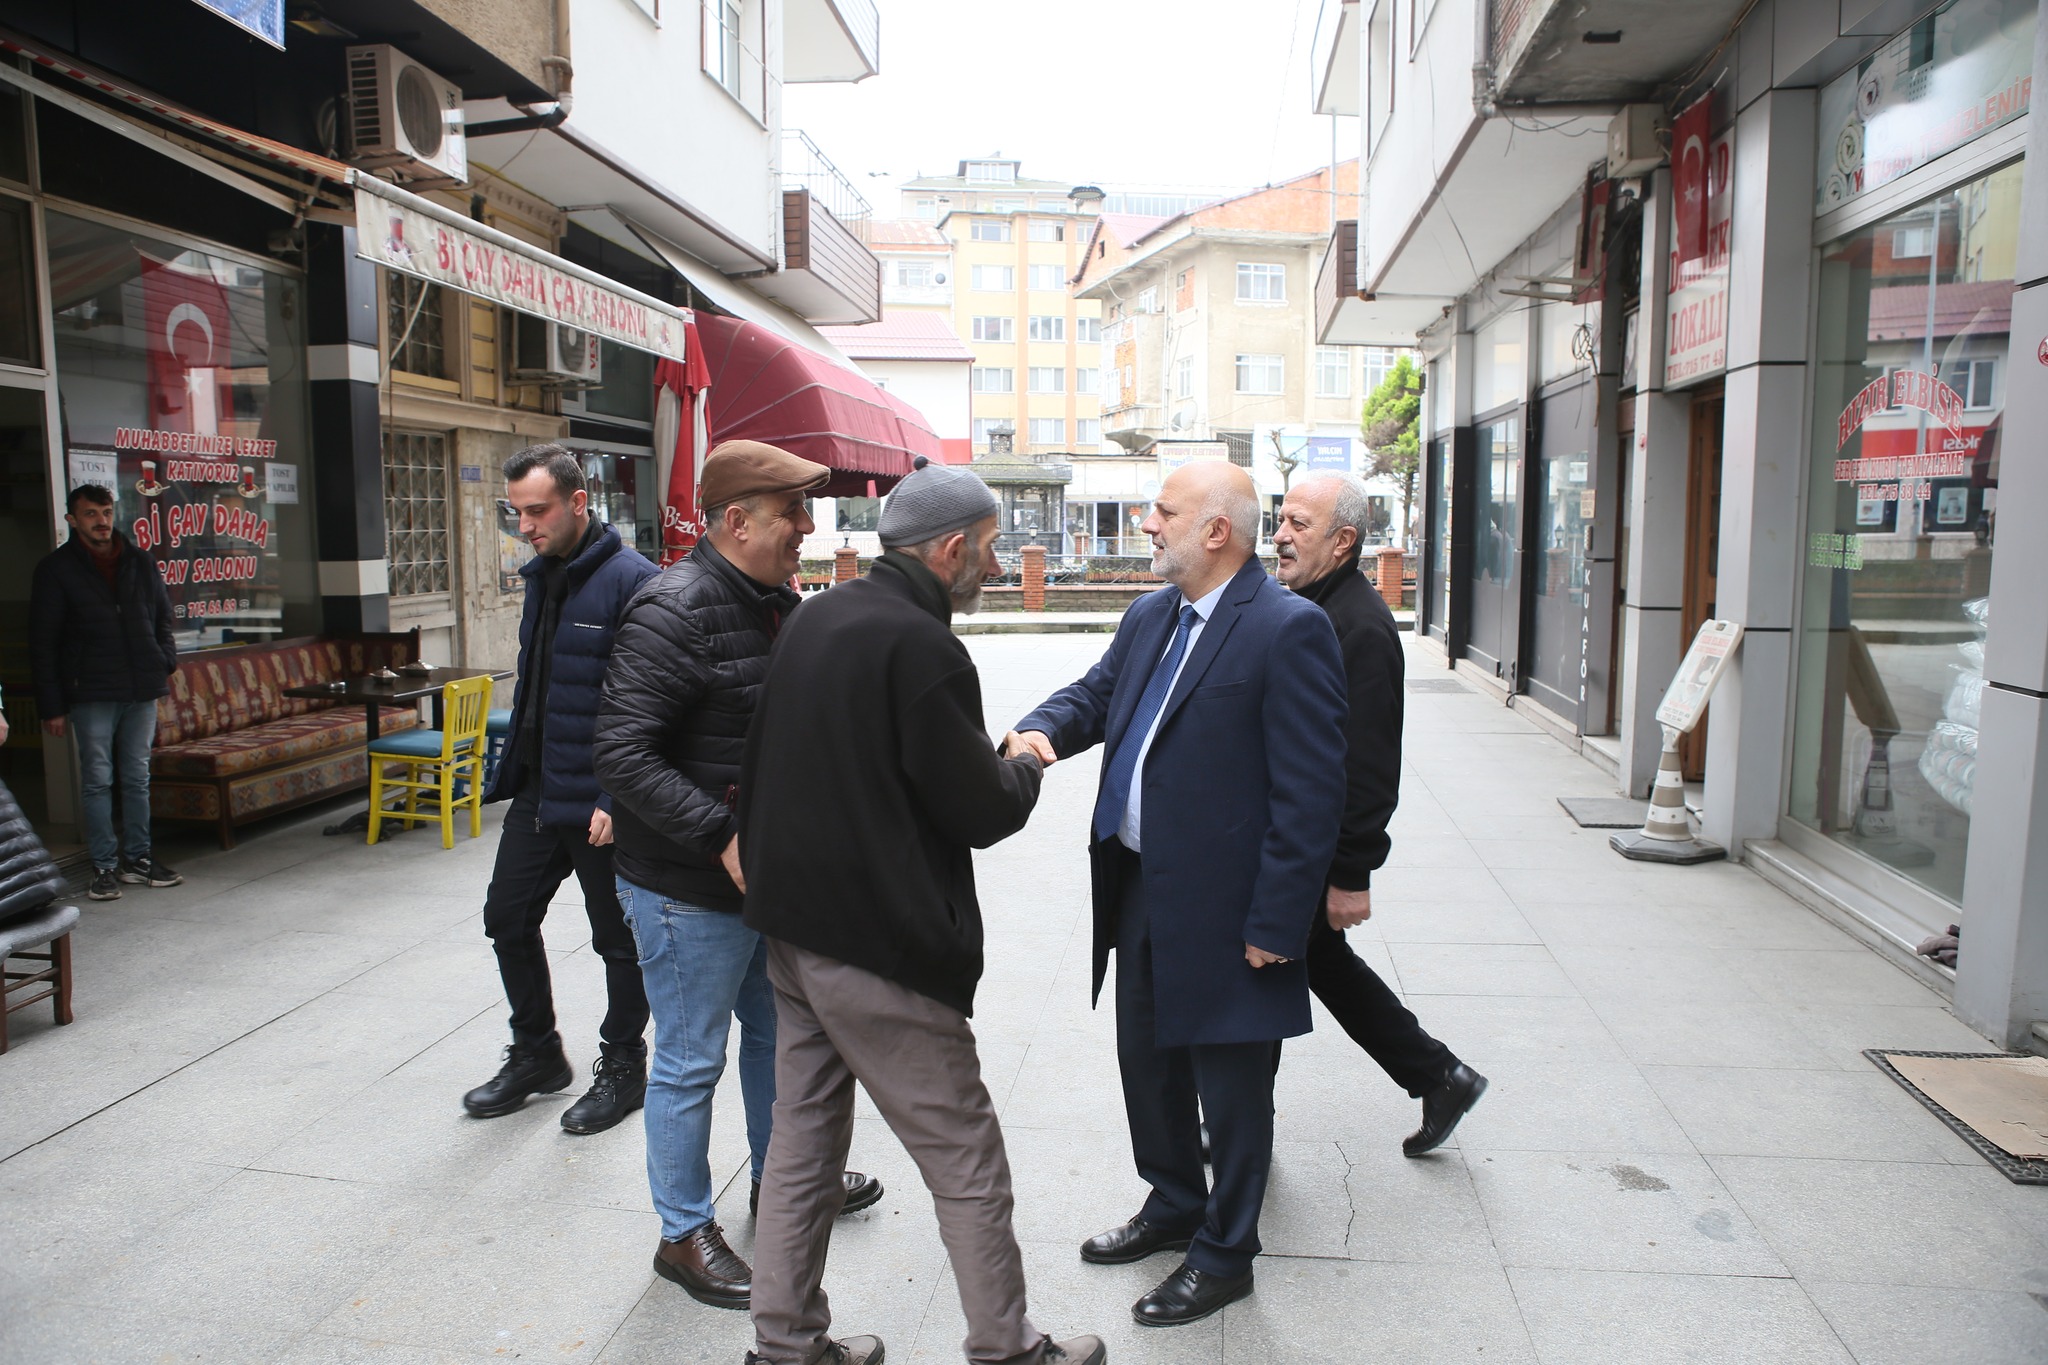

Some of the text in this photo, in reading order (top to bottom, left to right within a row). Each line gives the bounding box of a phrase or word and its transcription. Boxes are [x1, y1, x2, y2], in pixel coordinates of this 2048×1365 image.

[462, 240, 496, 289] ÇAY
[501, 255, 546, 305] DAHA
[591, 290, 647, 339] SALONU
[1836, 363, 1964, 452] HIZIR ELBİSE
[114, 427, 278, 459] MUHABBETİNİZE LEZZET
[79, 461, 106, 472] TOST
[167, 460, 240, 483] KATIYORUZ
[272, 468, 290, 478] TOST
[1915, 482, 1932, 501] 44
[133, 503, 268, 551] Bİ ÇAY DAHA
[192, 556, 257, 583] SALONU
[187, 598, 237, 618] 715 66 69
[1580, 568, 1591, 701] KUAFÖR
